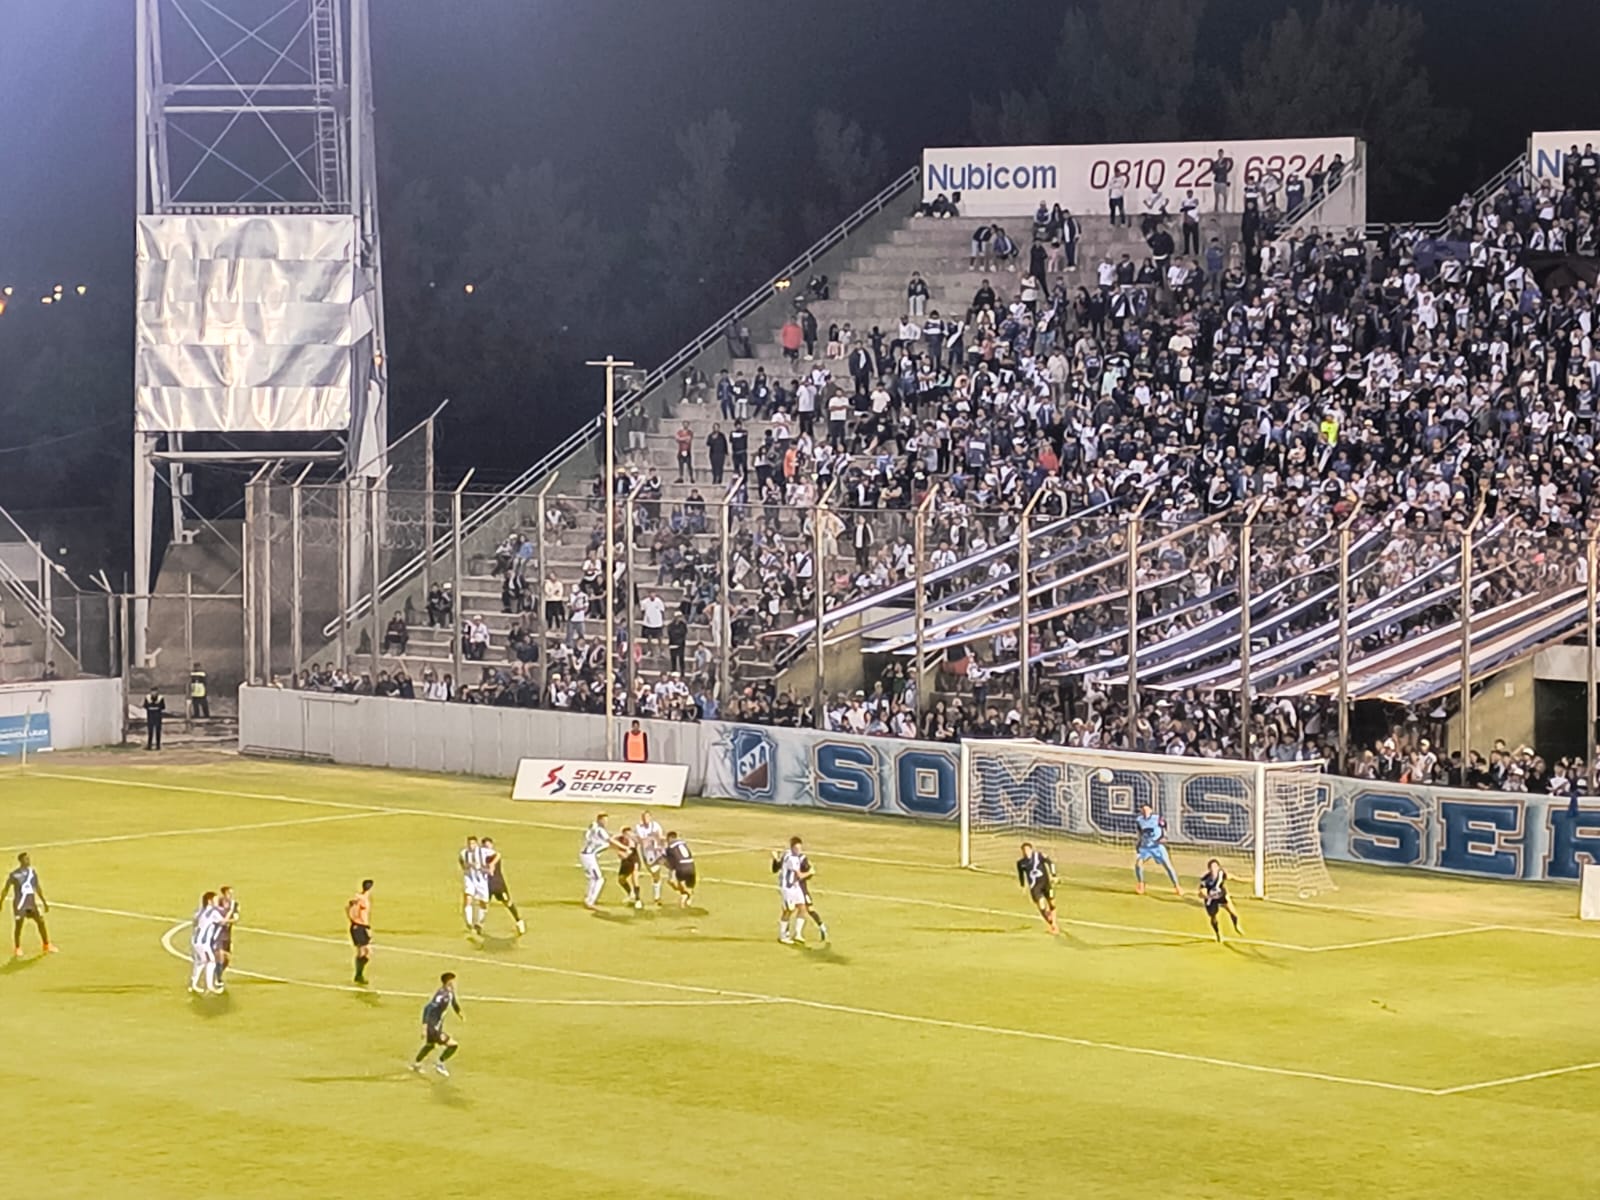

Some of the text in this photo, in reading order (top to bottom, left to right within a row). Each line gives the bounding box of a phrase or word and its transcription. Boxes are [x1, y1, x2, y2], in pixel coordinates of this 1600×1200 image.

[928, 163, 1056, 190] Nubicom
[1090, 159, 1165, 189] 0810
[573, 769, 632, 782] SALTA
[569, 782, 657, 795] DEPORTES
[813, 739, 1254, 847] SOMOS
